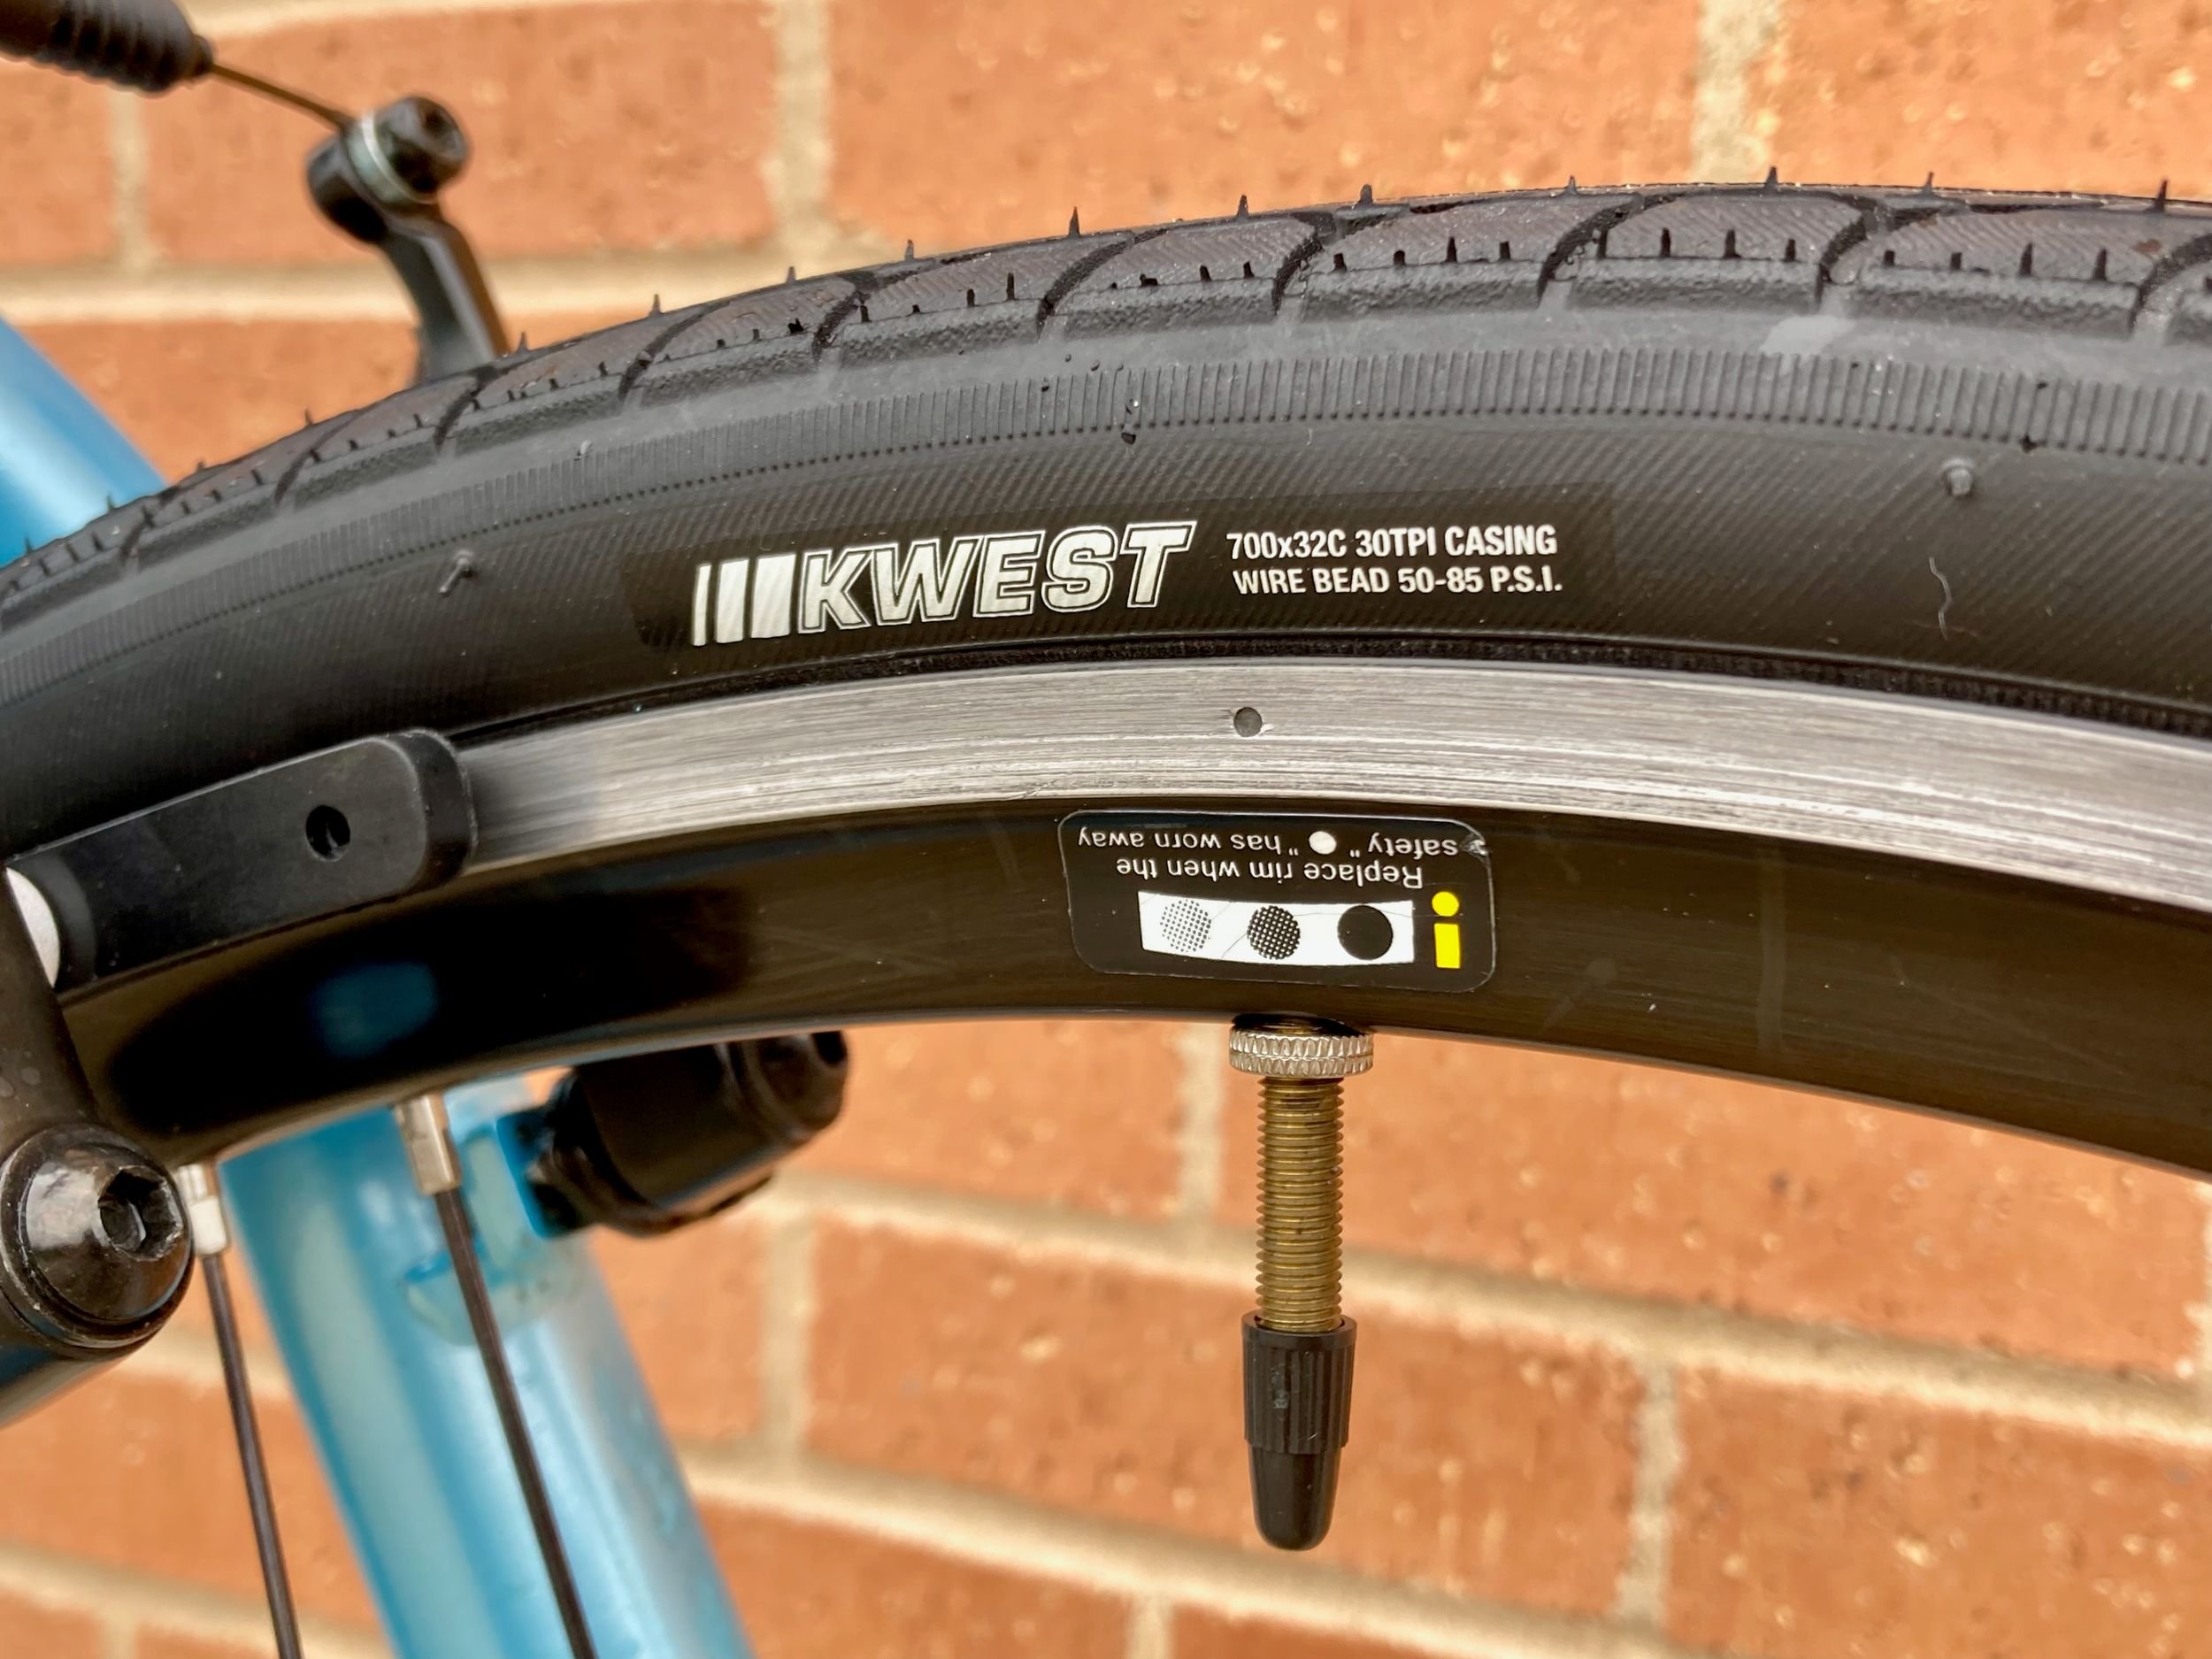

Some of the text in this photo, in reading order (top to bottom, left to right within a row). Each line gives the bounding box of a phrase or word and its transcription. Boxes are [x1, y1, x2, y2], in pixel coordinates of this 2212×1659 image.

[1225, 524, 1557, 560] 700x32C 30TPI CASING
[797, 519, 1198, 634] KWEST
[1232, 565, 1563, 595] WIRE BEAD 50-85 P.S.I.
[1078, 826, 1145, 848] away
[1154, 833, 1222, 849] worn
[1368, 832, 1458, 860] safety
[1116, 858, 1423, 889] Replace rim when the
